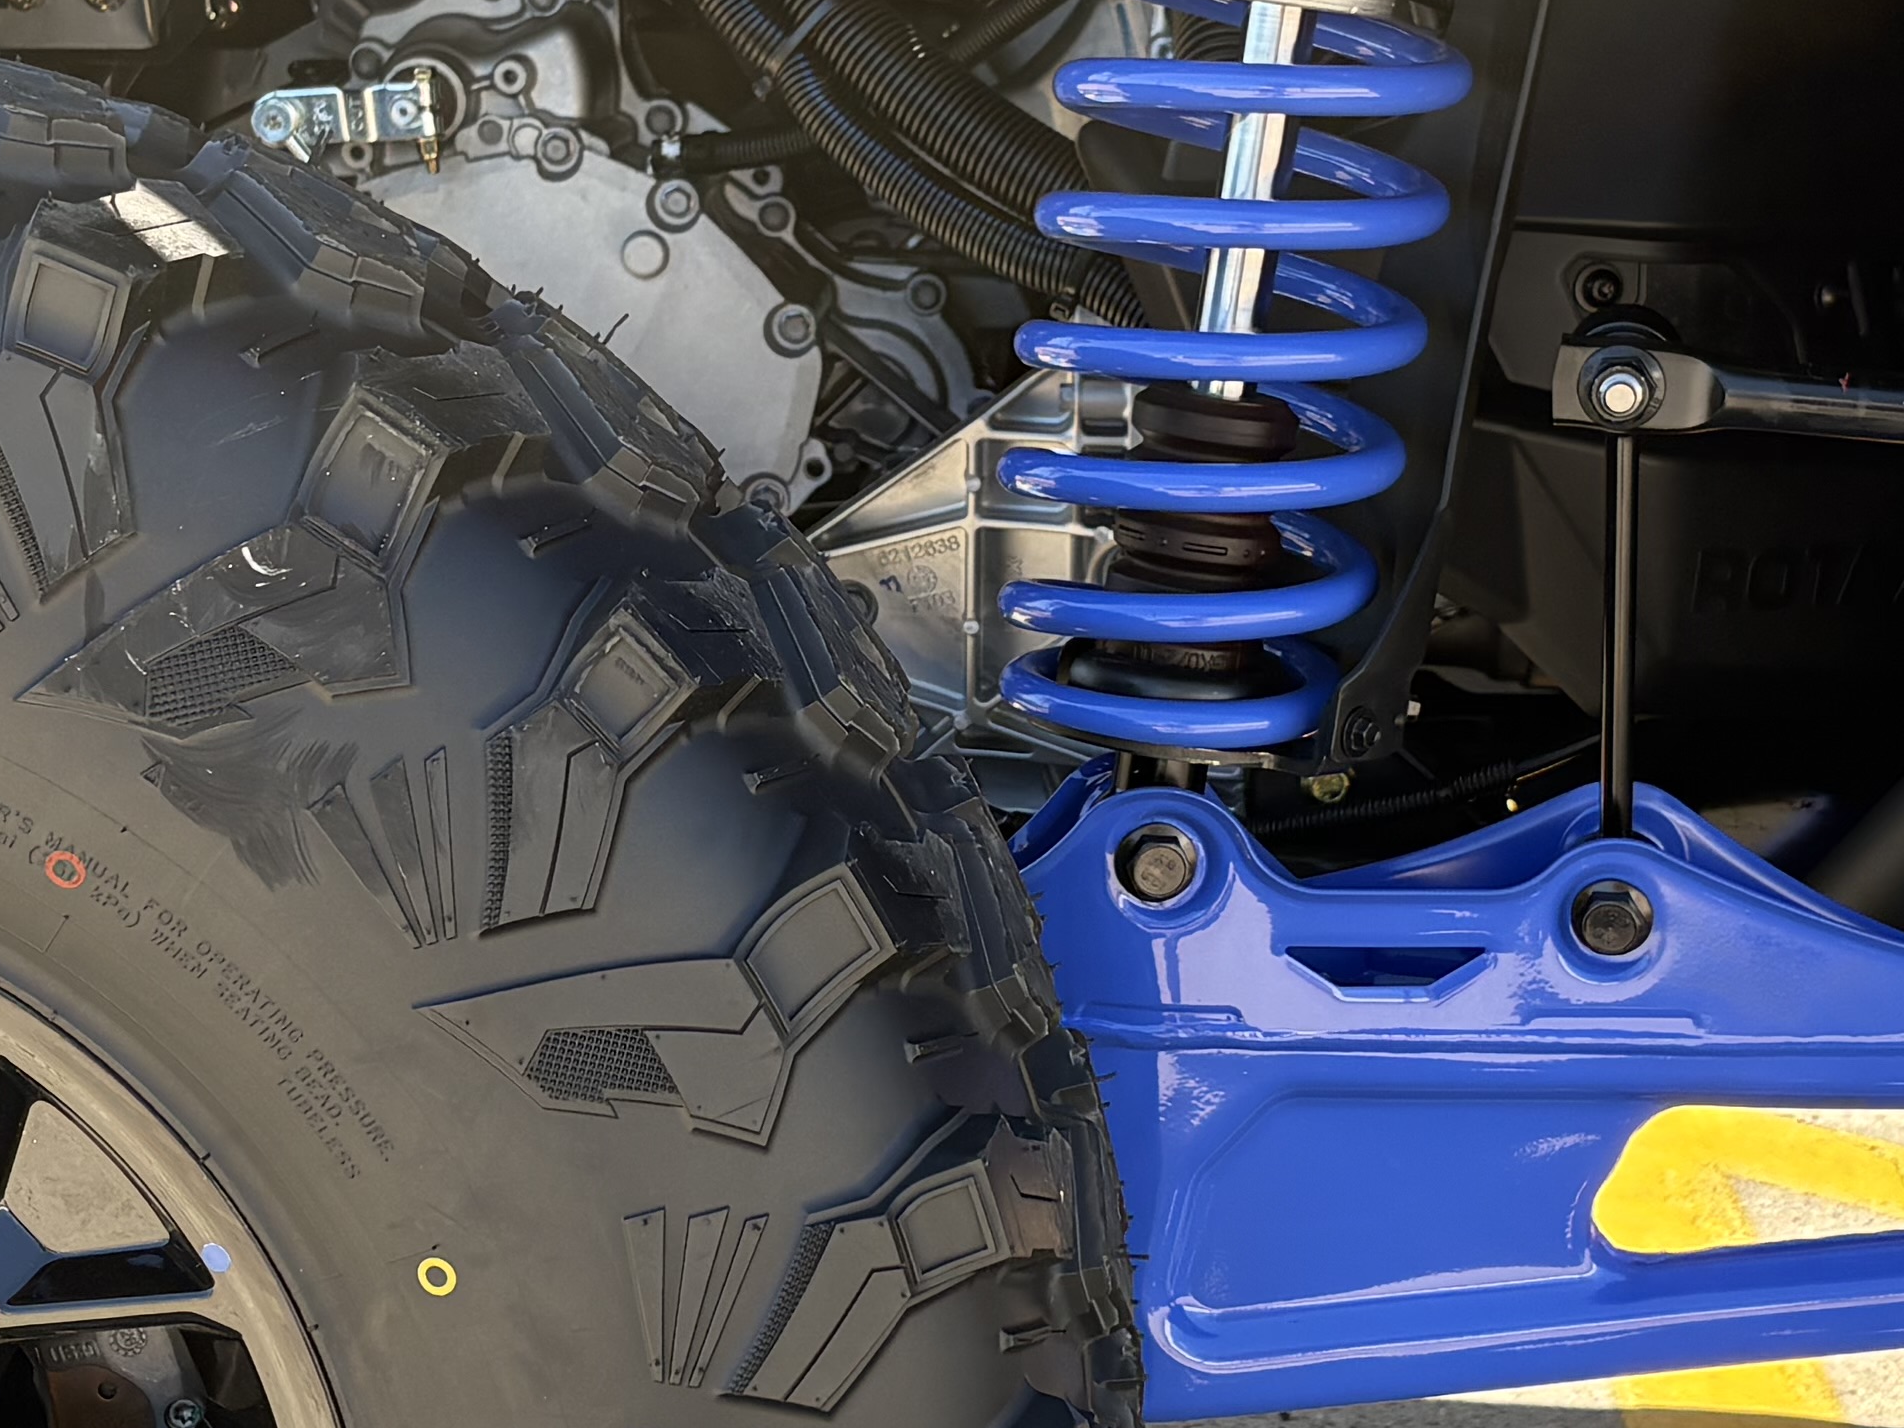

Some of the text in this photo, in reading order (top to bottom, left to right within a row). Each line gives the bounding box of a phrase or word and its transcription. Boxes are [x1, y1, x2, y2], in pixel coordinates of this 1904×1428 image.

[143, 898, 188, 937] FOR
[196, 940, 304, 1044] OPERATING
[151, 928, 207, 978] WHEN
[277, 1077, 361, 1179] TUBELESS
